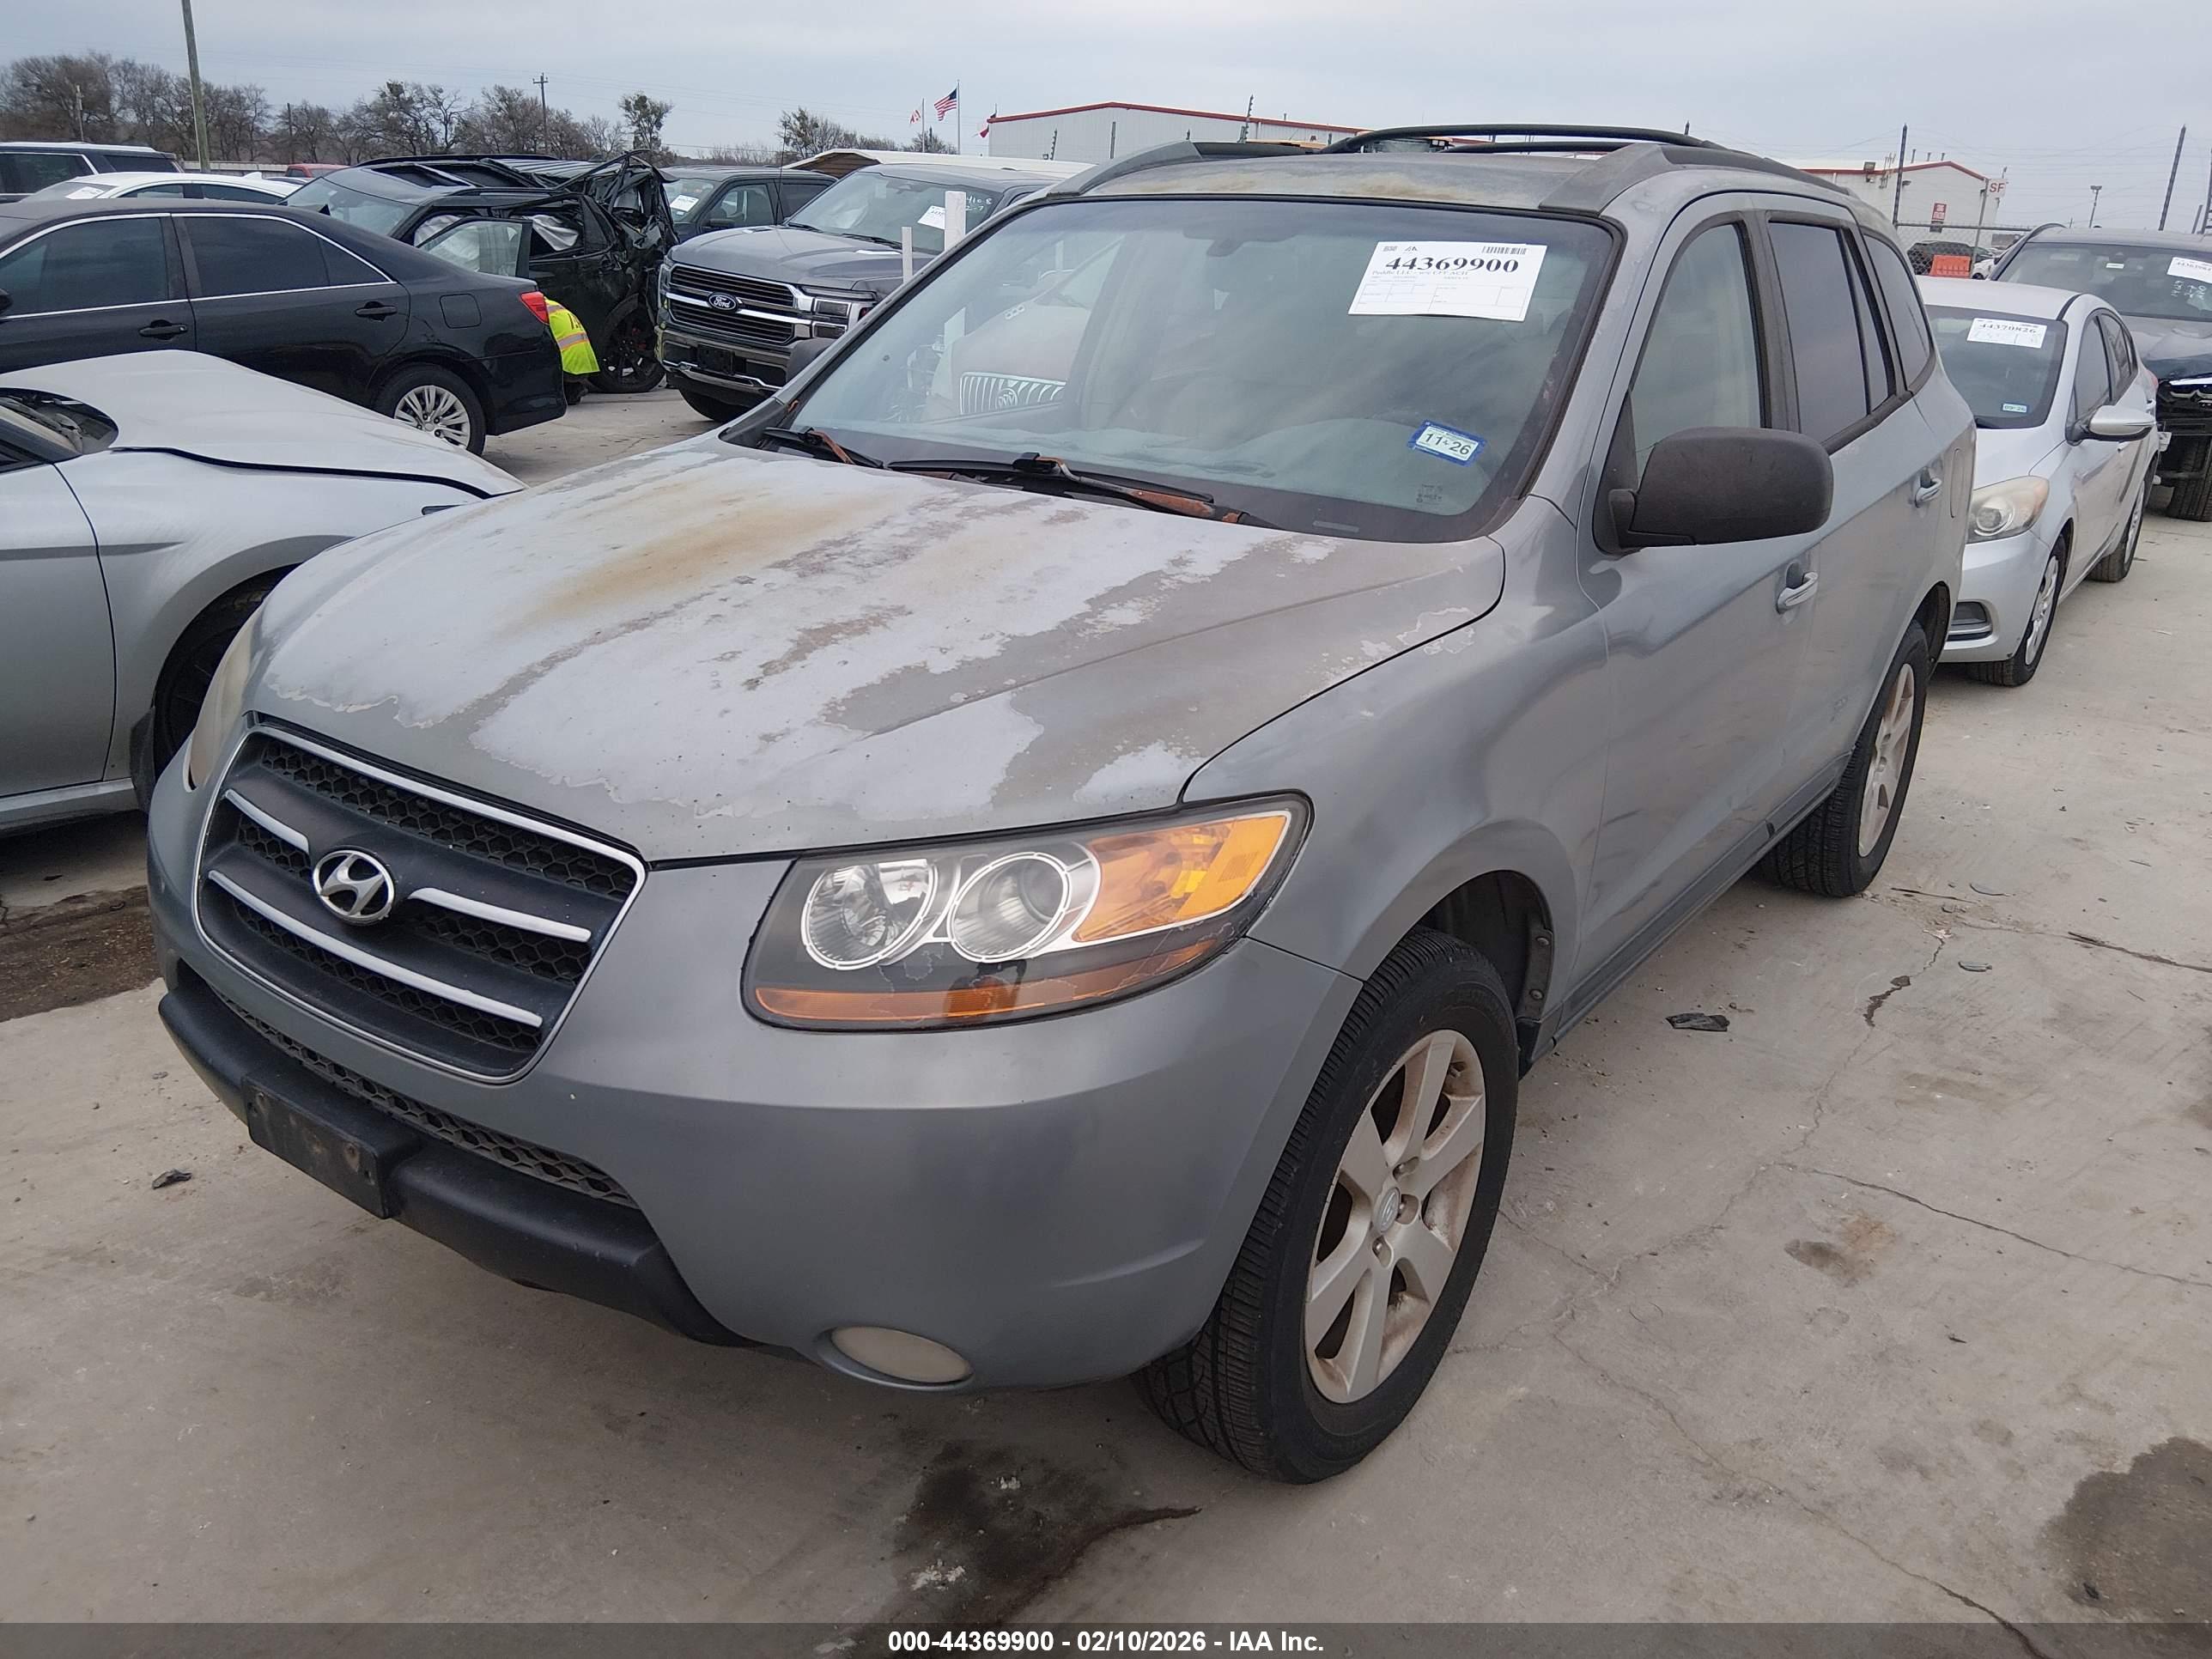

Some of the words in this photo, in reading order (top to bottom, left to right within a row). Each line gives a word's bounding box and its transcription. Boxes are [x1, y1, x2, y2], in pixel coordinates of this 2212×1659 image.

[1989, 182, 2005, 193] SF
[1385, 256, 1519, 273] 44369900
[713, 296, 732, 308] Ford
